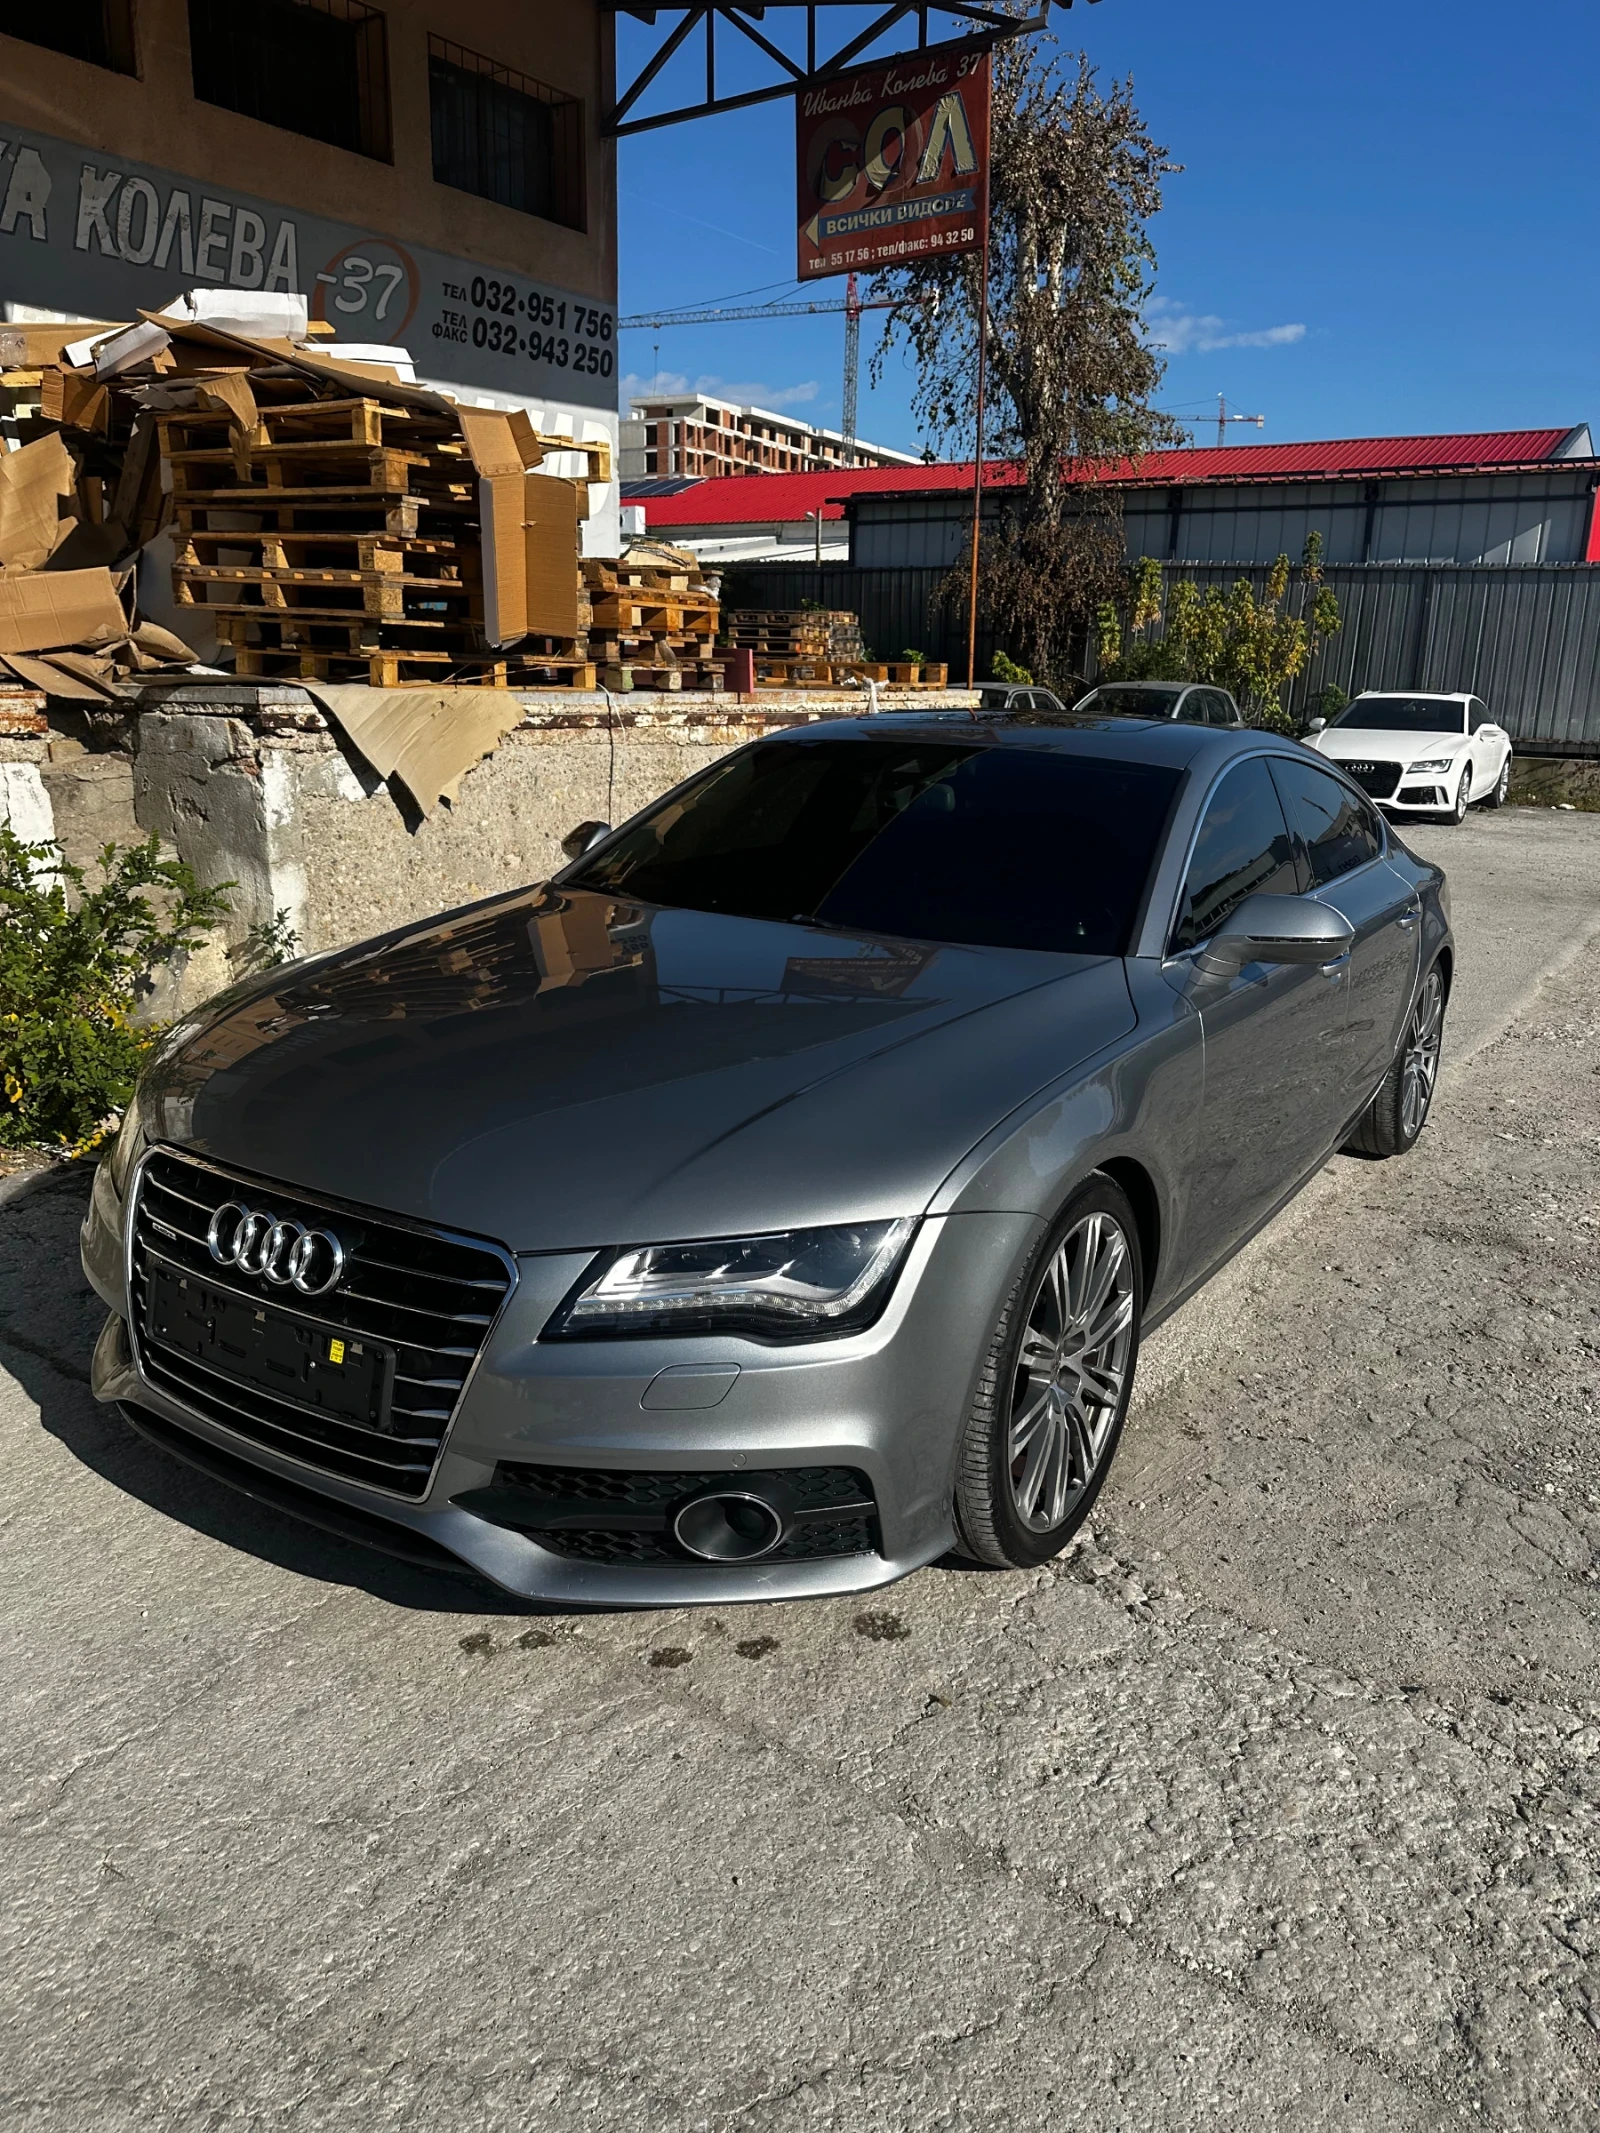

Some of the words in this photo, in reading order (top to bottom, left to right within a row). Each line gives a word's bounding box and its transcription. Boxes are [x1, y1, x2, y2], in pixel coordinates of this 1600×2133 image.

[803, 80, 872, 117] Иванка
[880, 62, 948, 98] Колева
[957, 52, 982, 77] 37
[806, 90, 979, 204] СОЛ
[75, 164, 300, 294] КОЛЕВА
[826, 209, 892, 235] ВСИЧКИ
[831, 252, 842, 266] 55
[846, 250, 854, 264] 17
[857, 247, 869, 262] 56
[931, 231, 943, 248] 94
[946, 230, 959, 245] 32
[961, 227, 974, 241] 50
[442, 282, 467, 302] ТЕЛ
[573, 305, 613, 342] 756
[442, 310, 467, 329] ТЕЛ
[432, 322, 468, 344] ФАКС
[572, 343, 613, 378] 250
